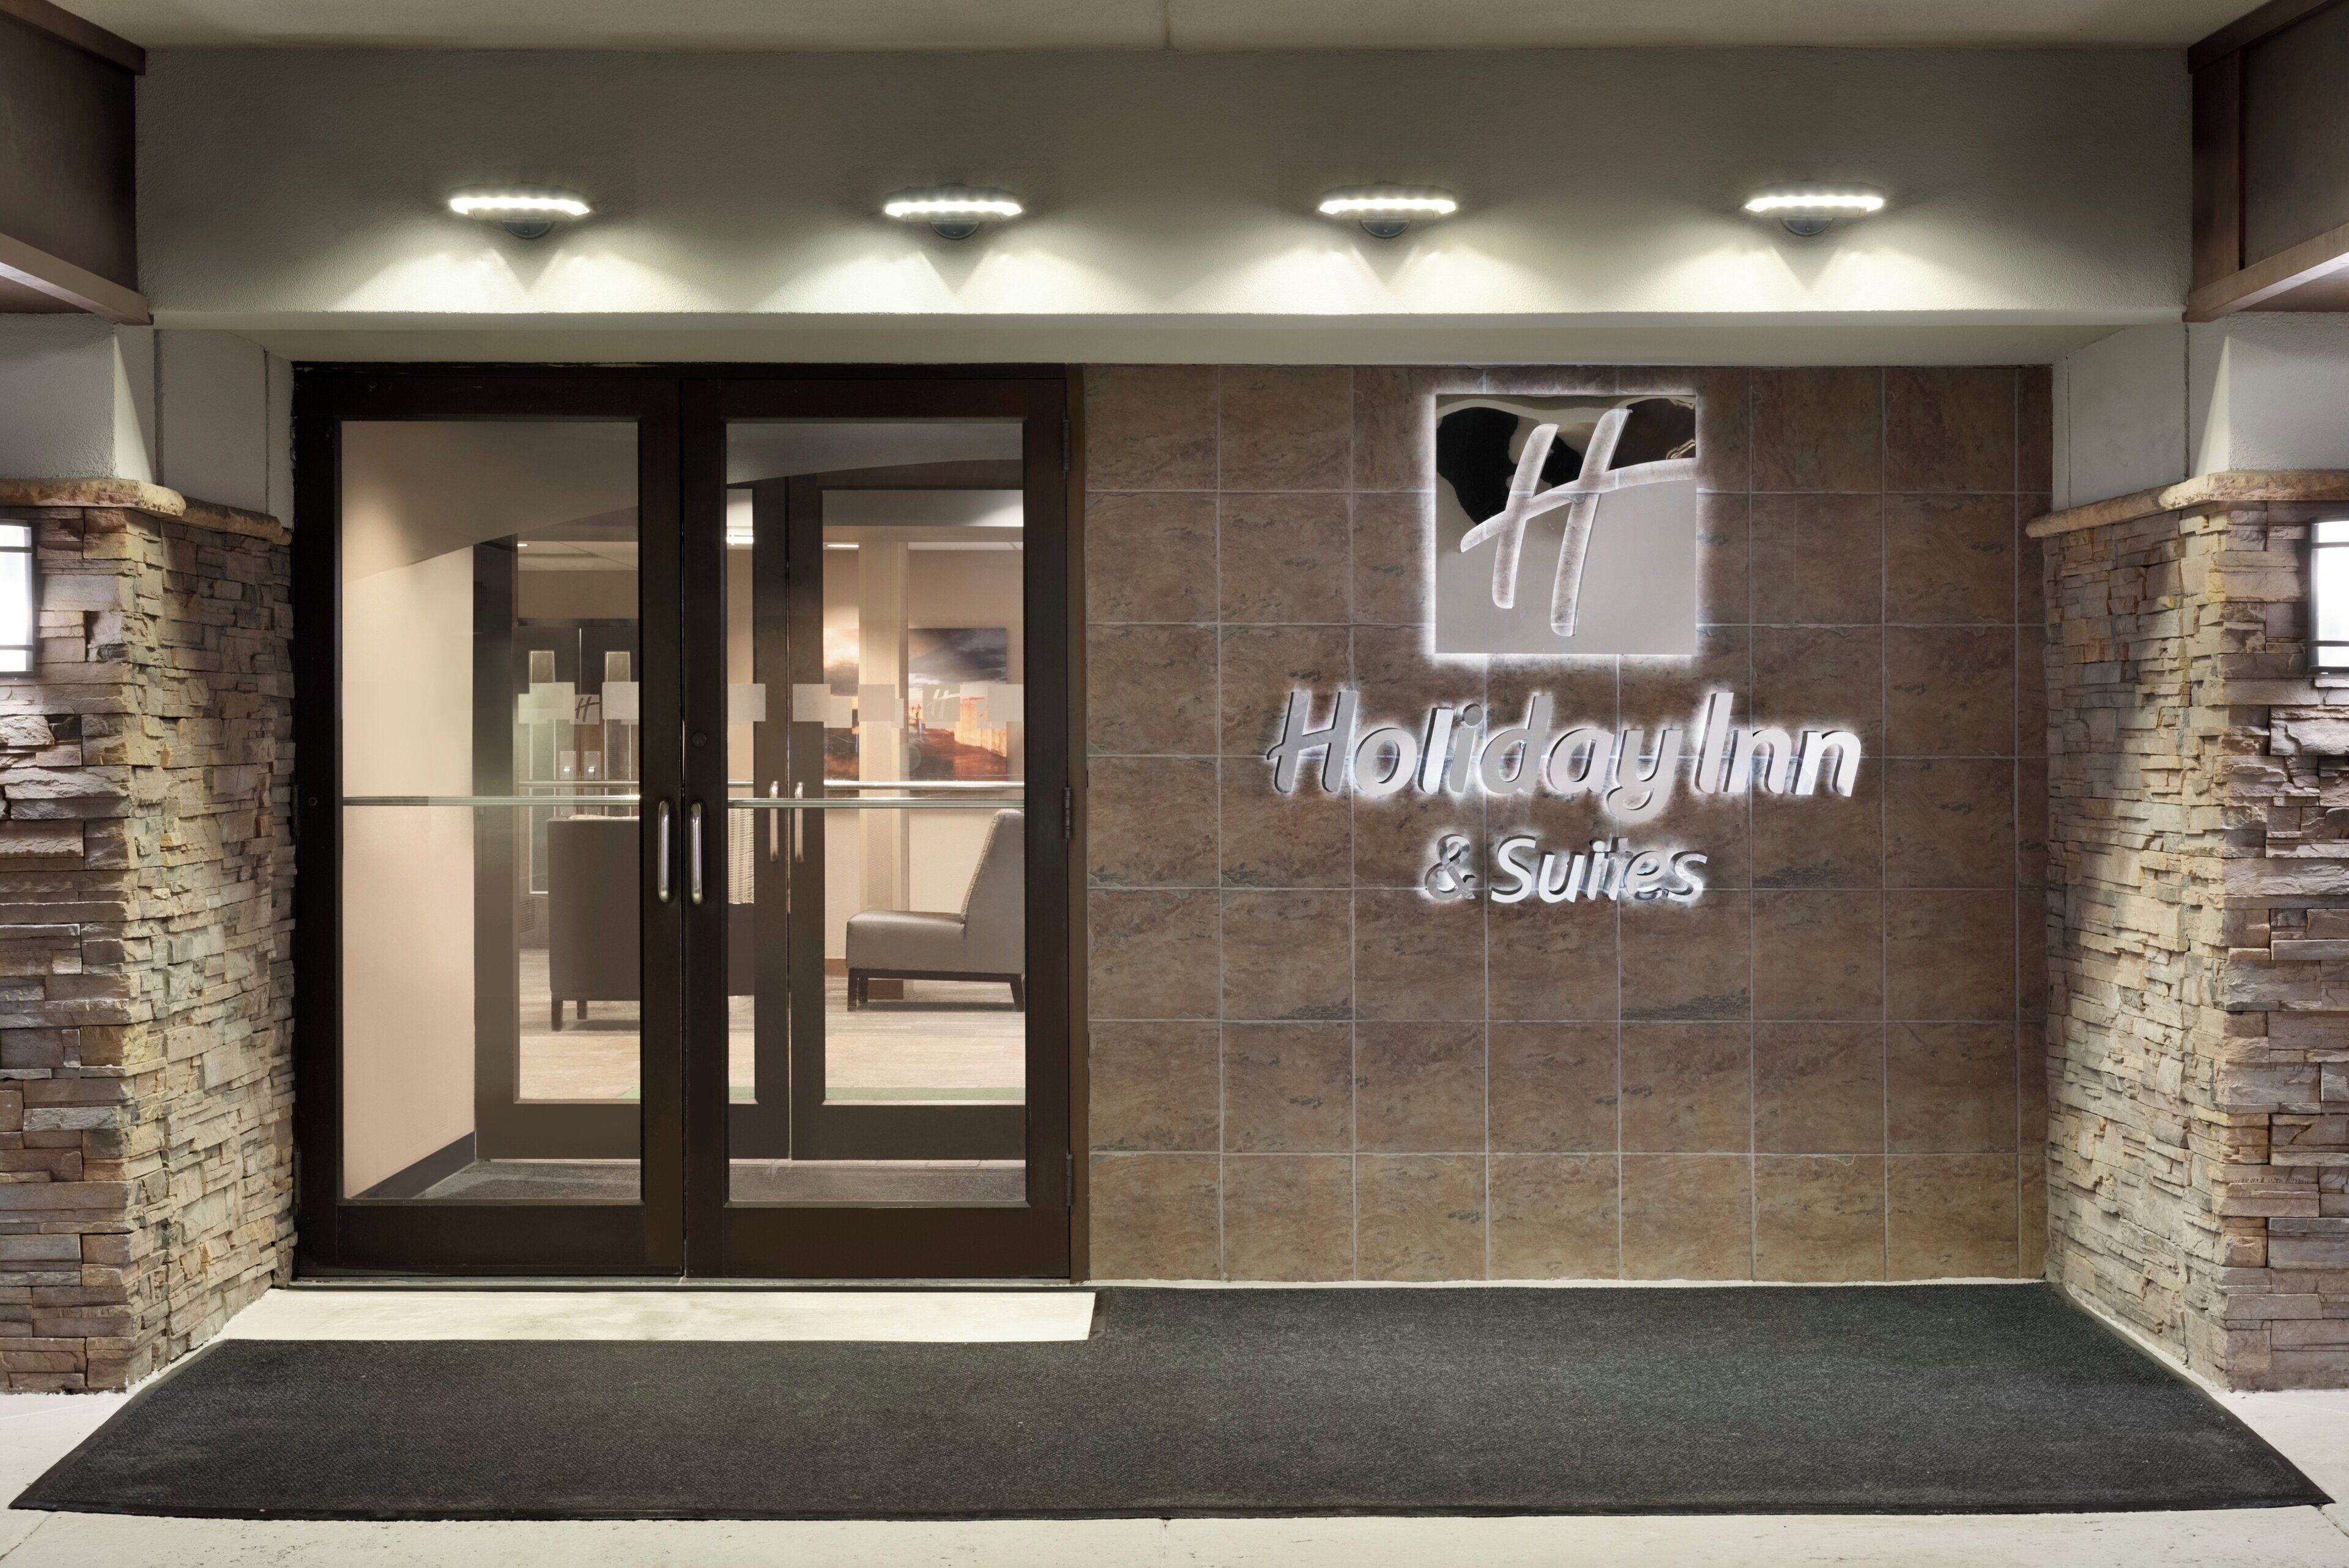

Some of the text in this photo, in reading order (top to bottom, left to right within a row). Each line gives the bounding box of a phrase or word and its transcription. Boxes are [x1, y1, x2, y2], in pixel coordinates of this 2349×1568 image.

[1267, 689, 1862, 820] Holiday Inn
[1424, 833, 1708, 903] & Suites
